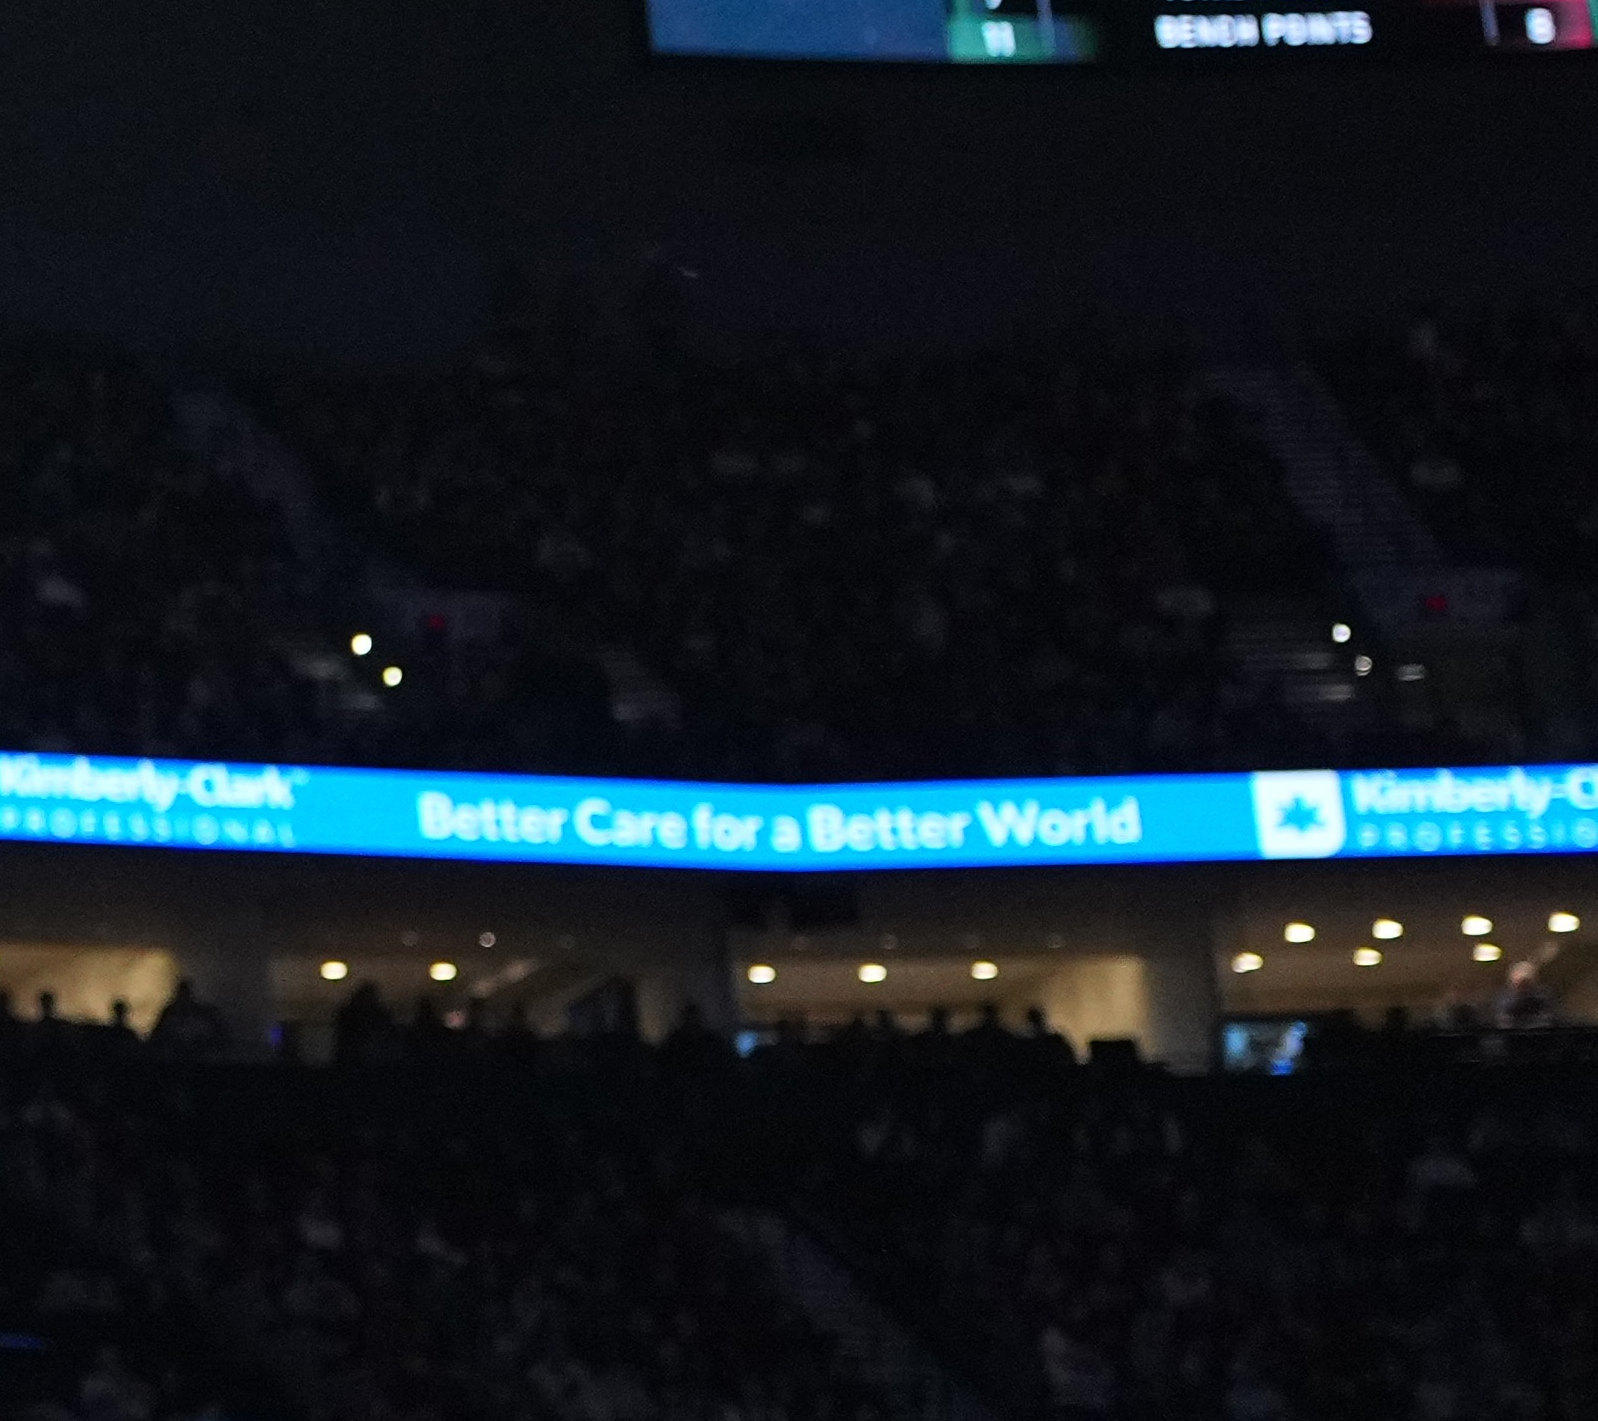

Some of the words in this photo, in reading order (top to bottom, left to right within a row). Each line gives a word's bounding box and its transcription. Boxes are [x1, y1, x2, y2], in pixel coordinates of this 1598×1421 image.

[1154, 14, 1260, 48] BENCH
[1261, 12, 1373, 47] POINTS
[420, 792, 565, 842] Better
[576, 799, 686, 848] Care
[695, 805, 760, 849] for
[774, 818, 801, 850] a
[810, 806, 968, 851] Better
[979, 799, 1141, 845] World
